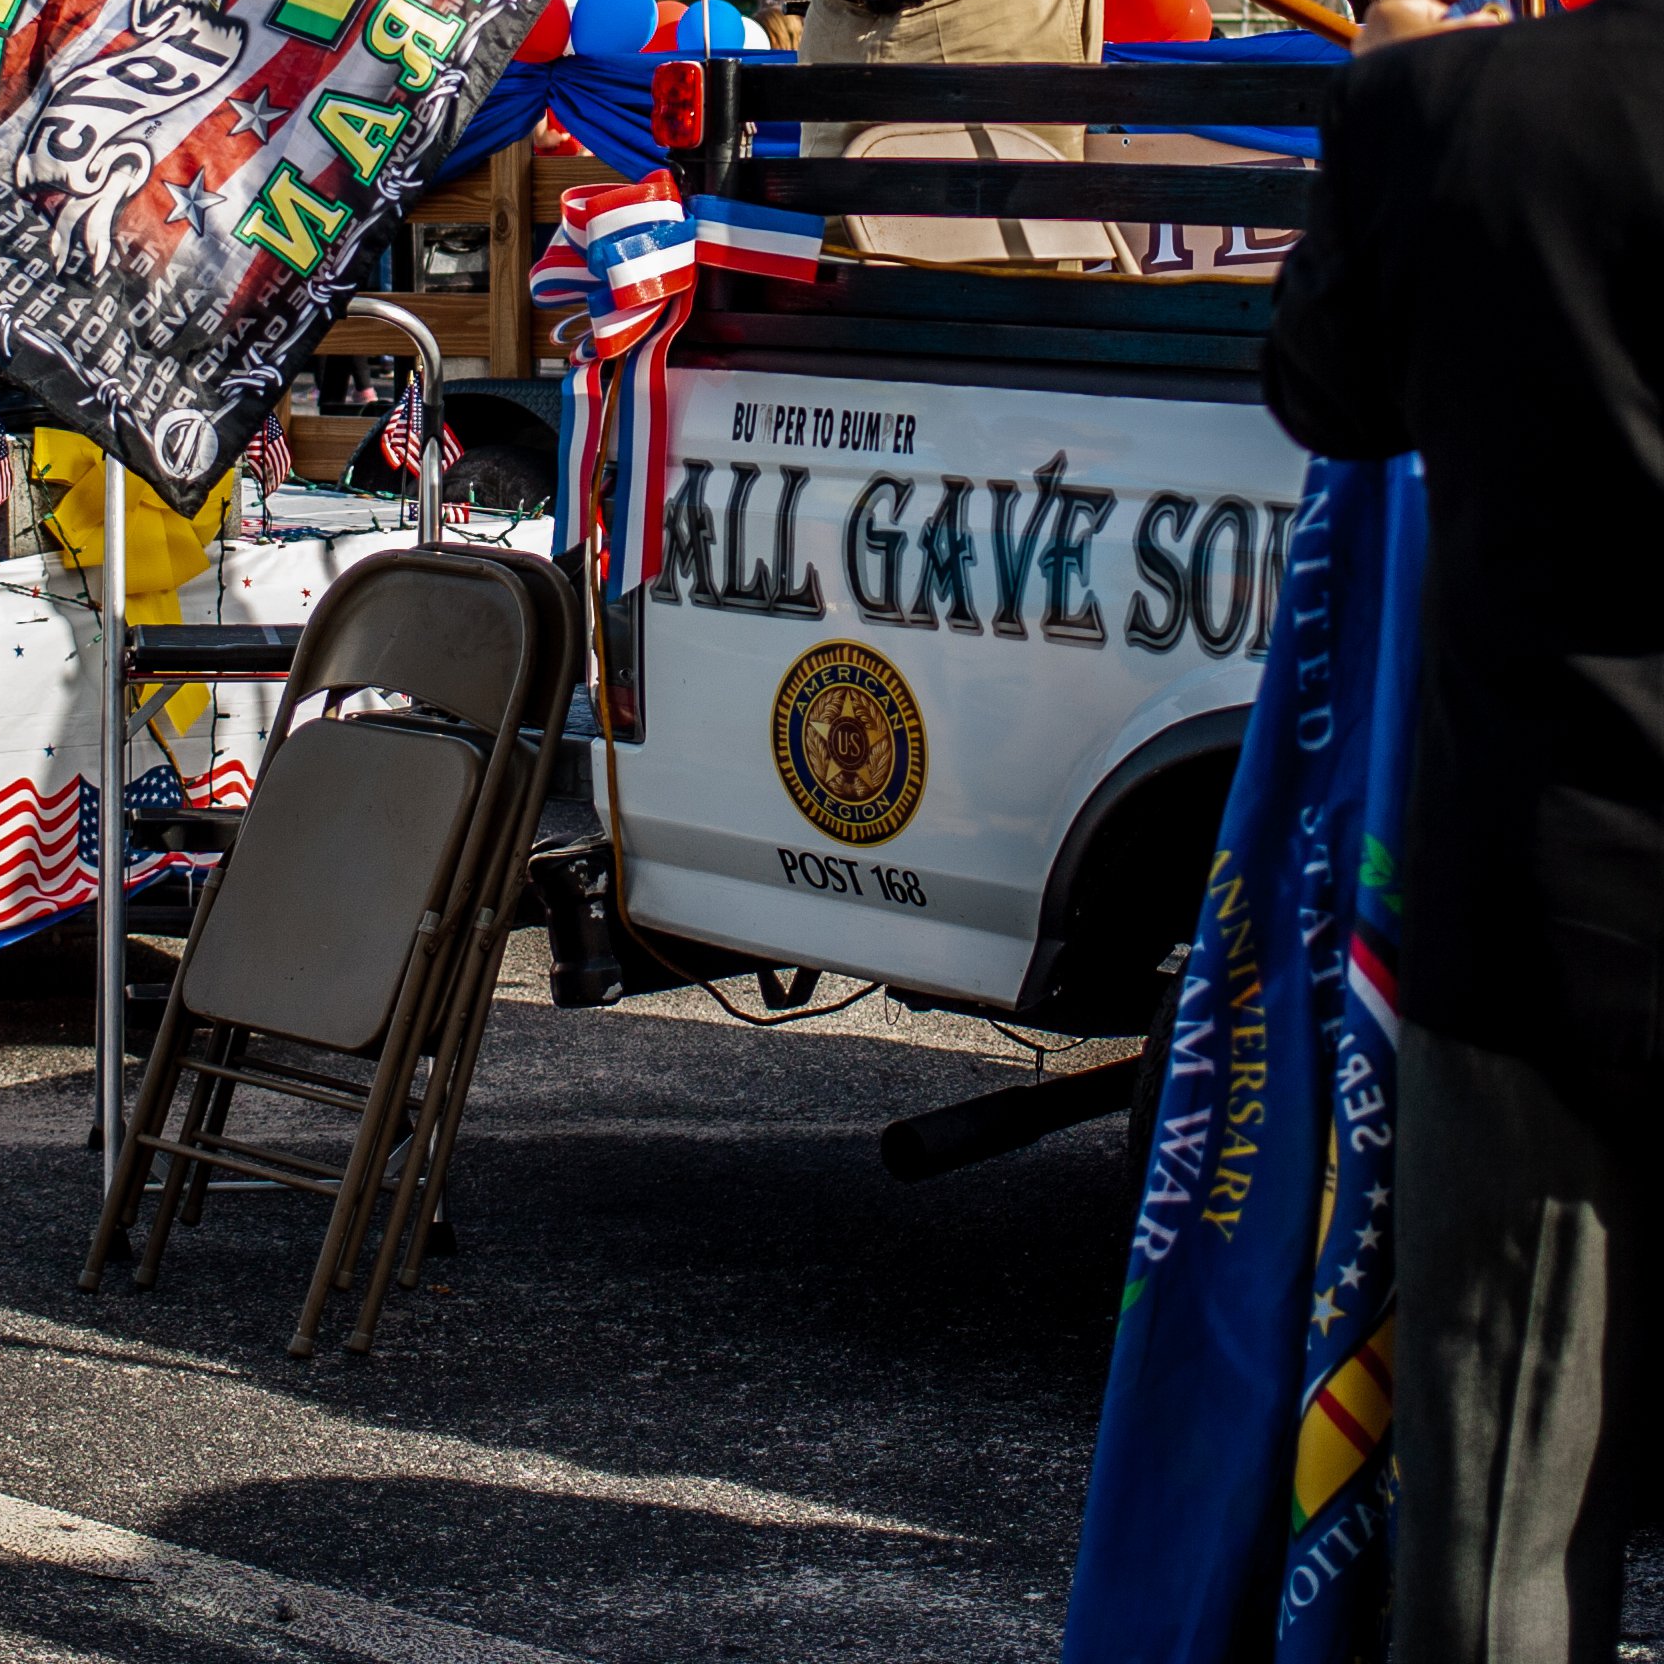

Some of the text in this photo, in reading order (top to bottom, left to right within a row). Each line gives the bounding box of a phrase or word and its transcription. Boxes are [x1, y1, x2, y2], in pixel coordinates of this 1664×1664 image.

[812, 407, 834, 449] TO
[650, 457, 827, 621] ALL
[842, 449, 1119, 650] GAVE
[1293, 486, 1334, 752] NITED
[795, 667, 904, 731] AMERICAN
[837, 730, 861, 757] US
[810, 785, 891, 821] LEGION
[777, 847, 927, 907] POST 168
[1132, 1105, 1214, 1261] WAR
